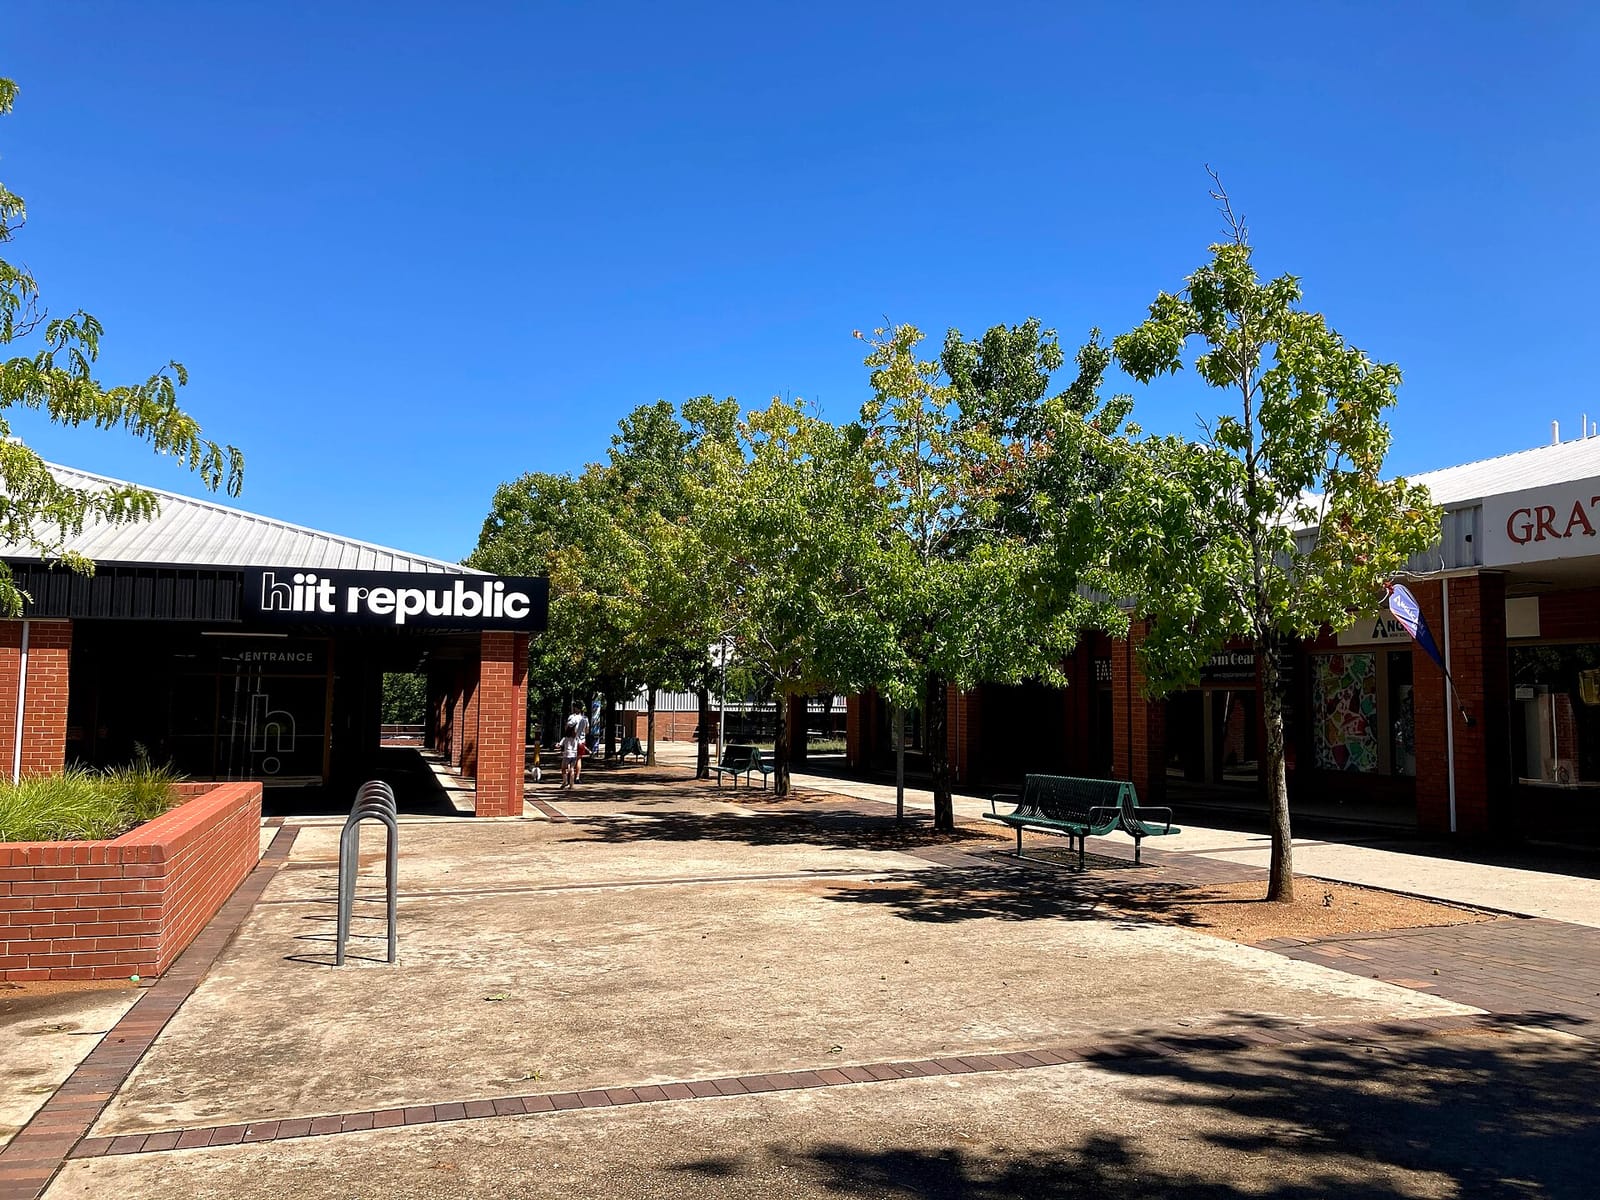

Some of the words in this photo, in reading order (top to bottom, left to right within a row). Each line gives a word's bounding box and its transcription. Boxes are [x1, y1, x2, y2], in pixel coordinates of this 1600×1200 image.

[261, 571, 336, 613] hiit
[347, 579, 531, 625] republic
[244, 651, 313, 663] ENTRANCE
